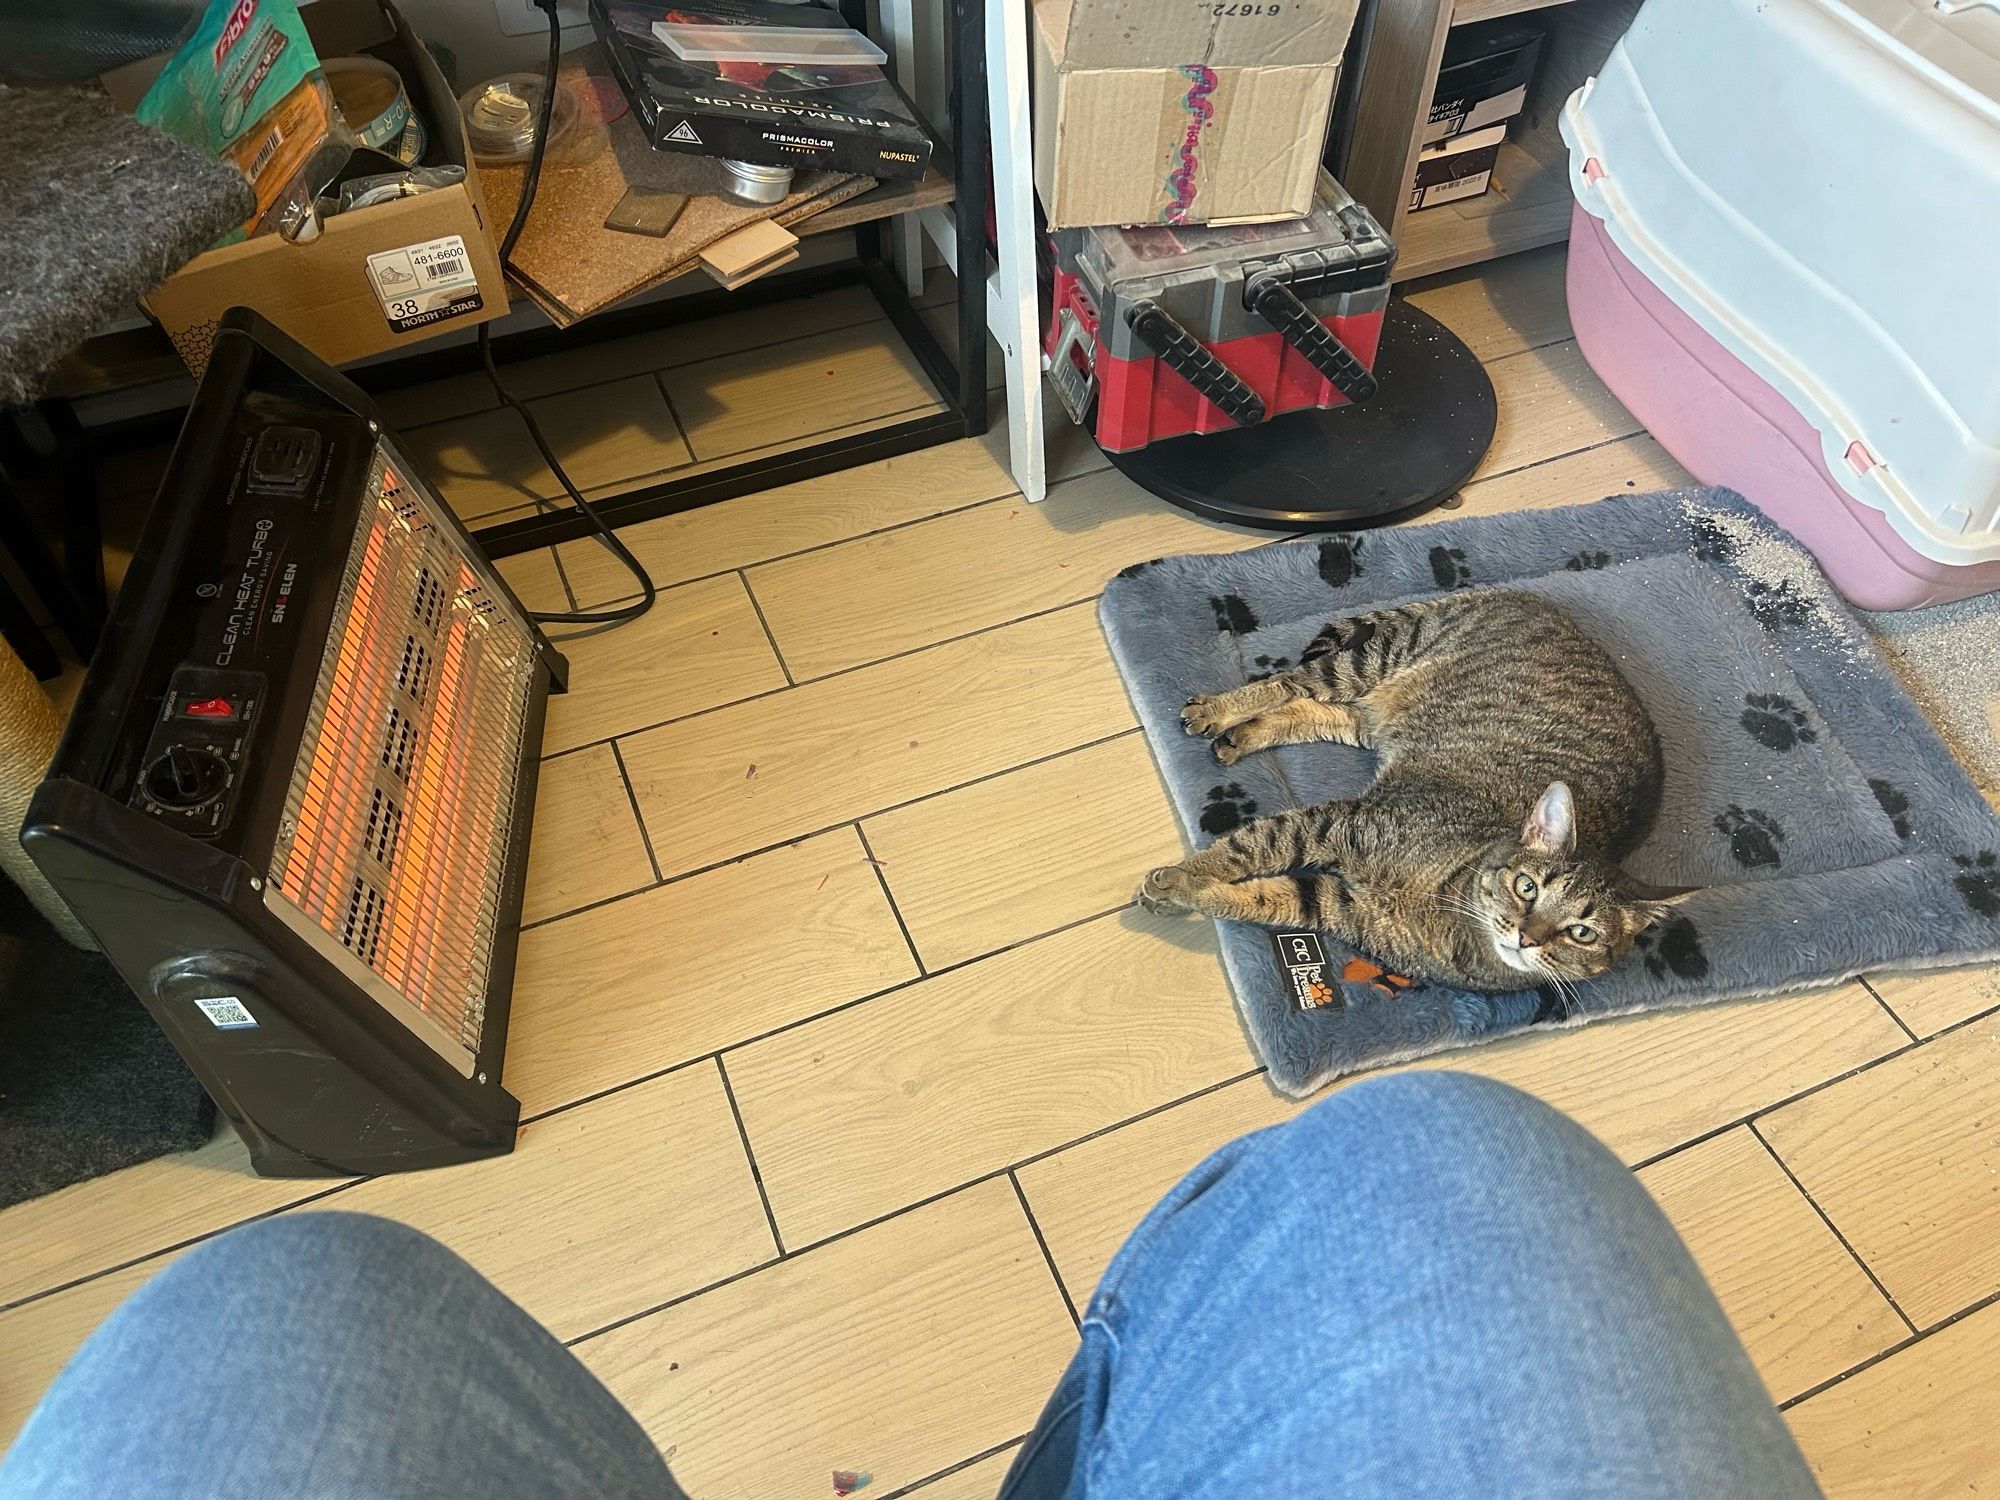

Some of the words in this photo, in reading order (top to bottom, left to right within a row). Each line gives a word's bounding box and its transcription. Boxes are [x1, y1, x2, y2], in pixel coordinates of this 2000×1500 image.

[1212, 3, 1281, 17] 61672
[693, 95, 892, 129] PRISMACOLOR
[679, 128, 689, 138] 96
[762, 132, 834, 148] PRISMACOLOR
[414, 247, 464, 266] 481-6600
[391, 299, 419, 319] 38
[401, 311, 440, 329] NORTH
[450, 300, 477, 314] STAR
[216, 614, 244, 667] CLEAN
[233, 572, 256, 611] HEAT
[1292, 938, 1311, 962] CIC
[1308, 964, 1324, 984] Pet
[1296, 966, 1317, 1009] Dreams
